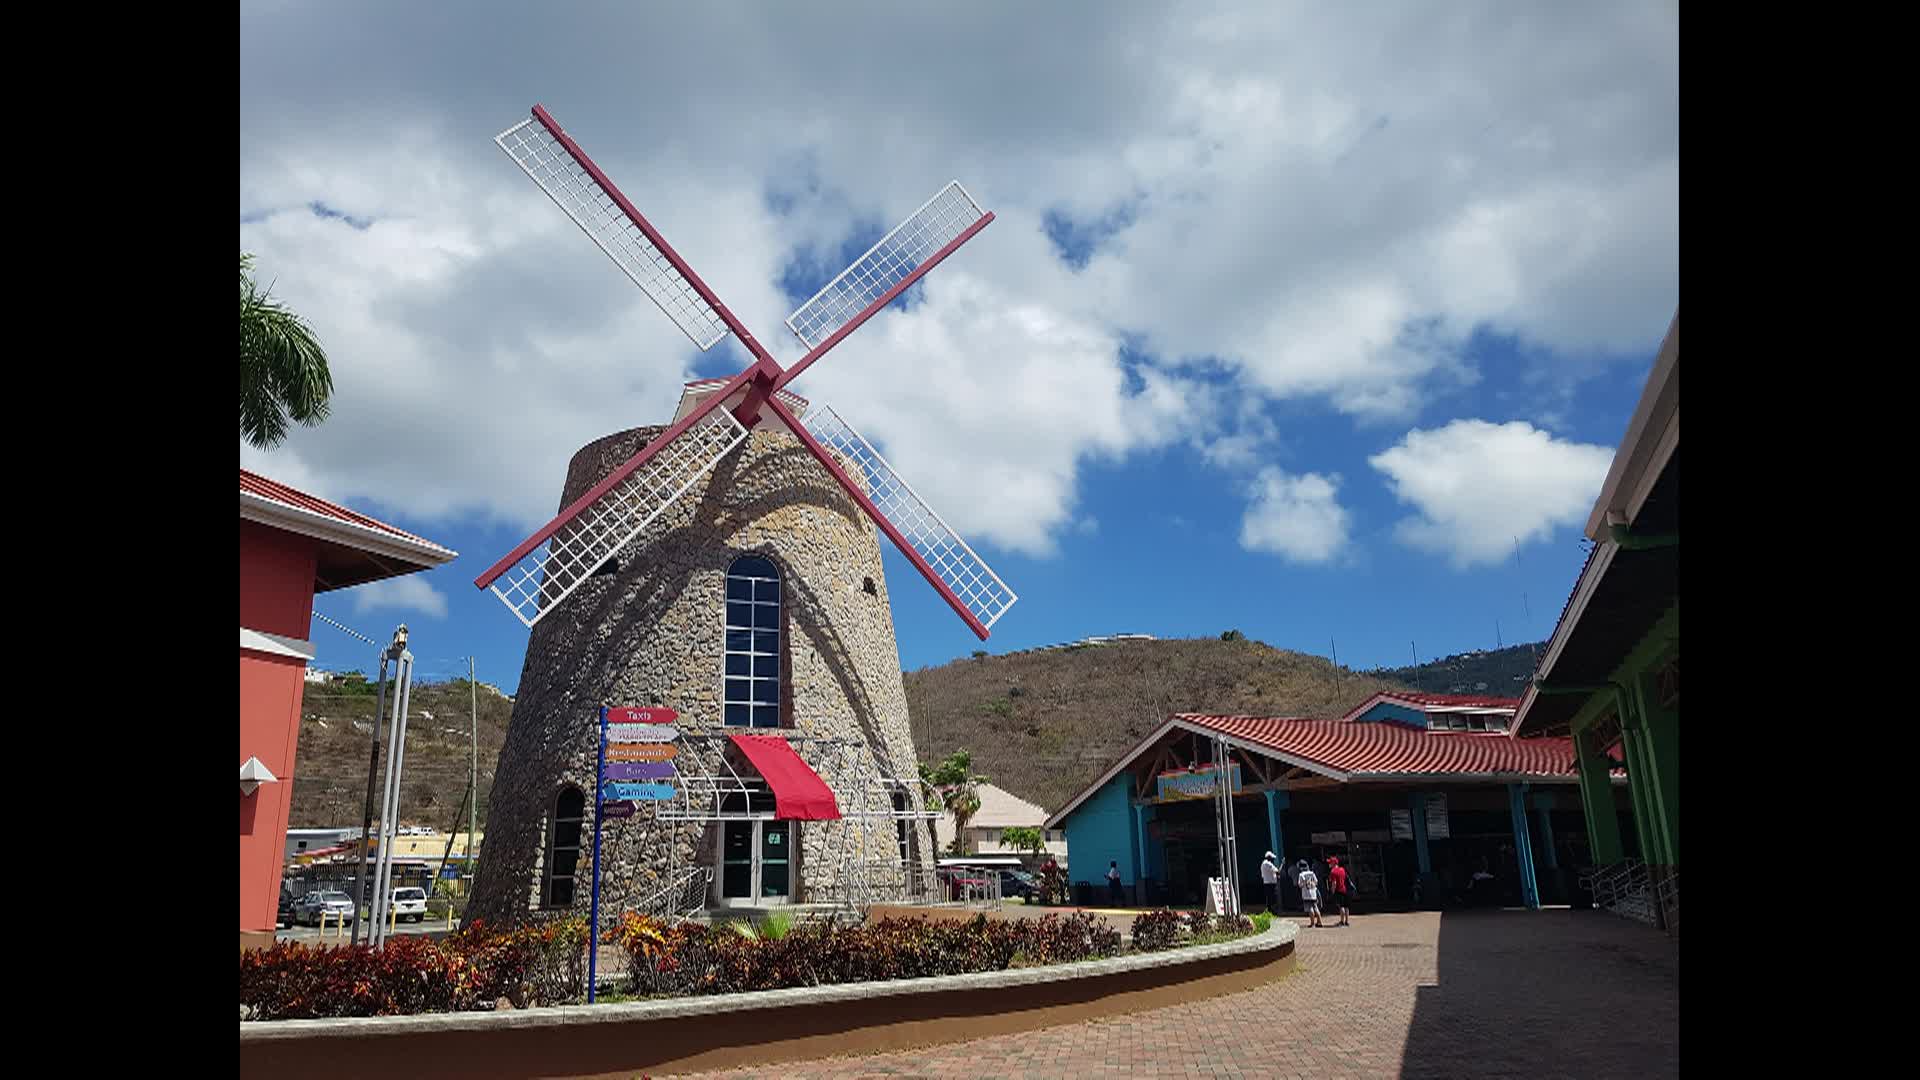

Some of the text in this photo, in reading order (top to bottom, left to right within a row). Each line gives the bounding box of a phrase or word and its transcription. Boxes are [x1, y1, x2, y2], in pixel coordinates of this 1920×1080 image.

[627, 711, 652, 720] Taxis
[608, 748, 667, 757] Restaurants
[626, 767, 647, 776] Bars
[618, 786, 655, 798] Gaming
